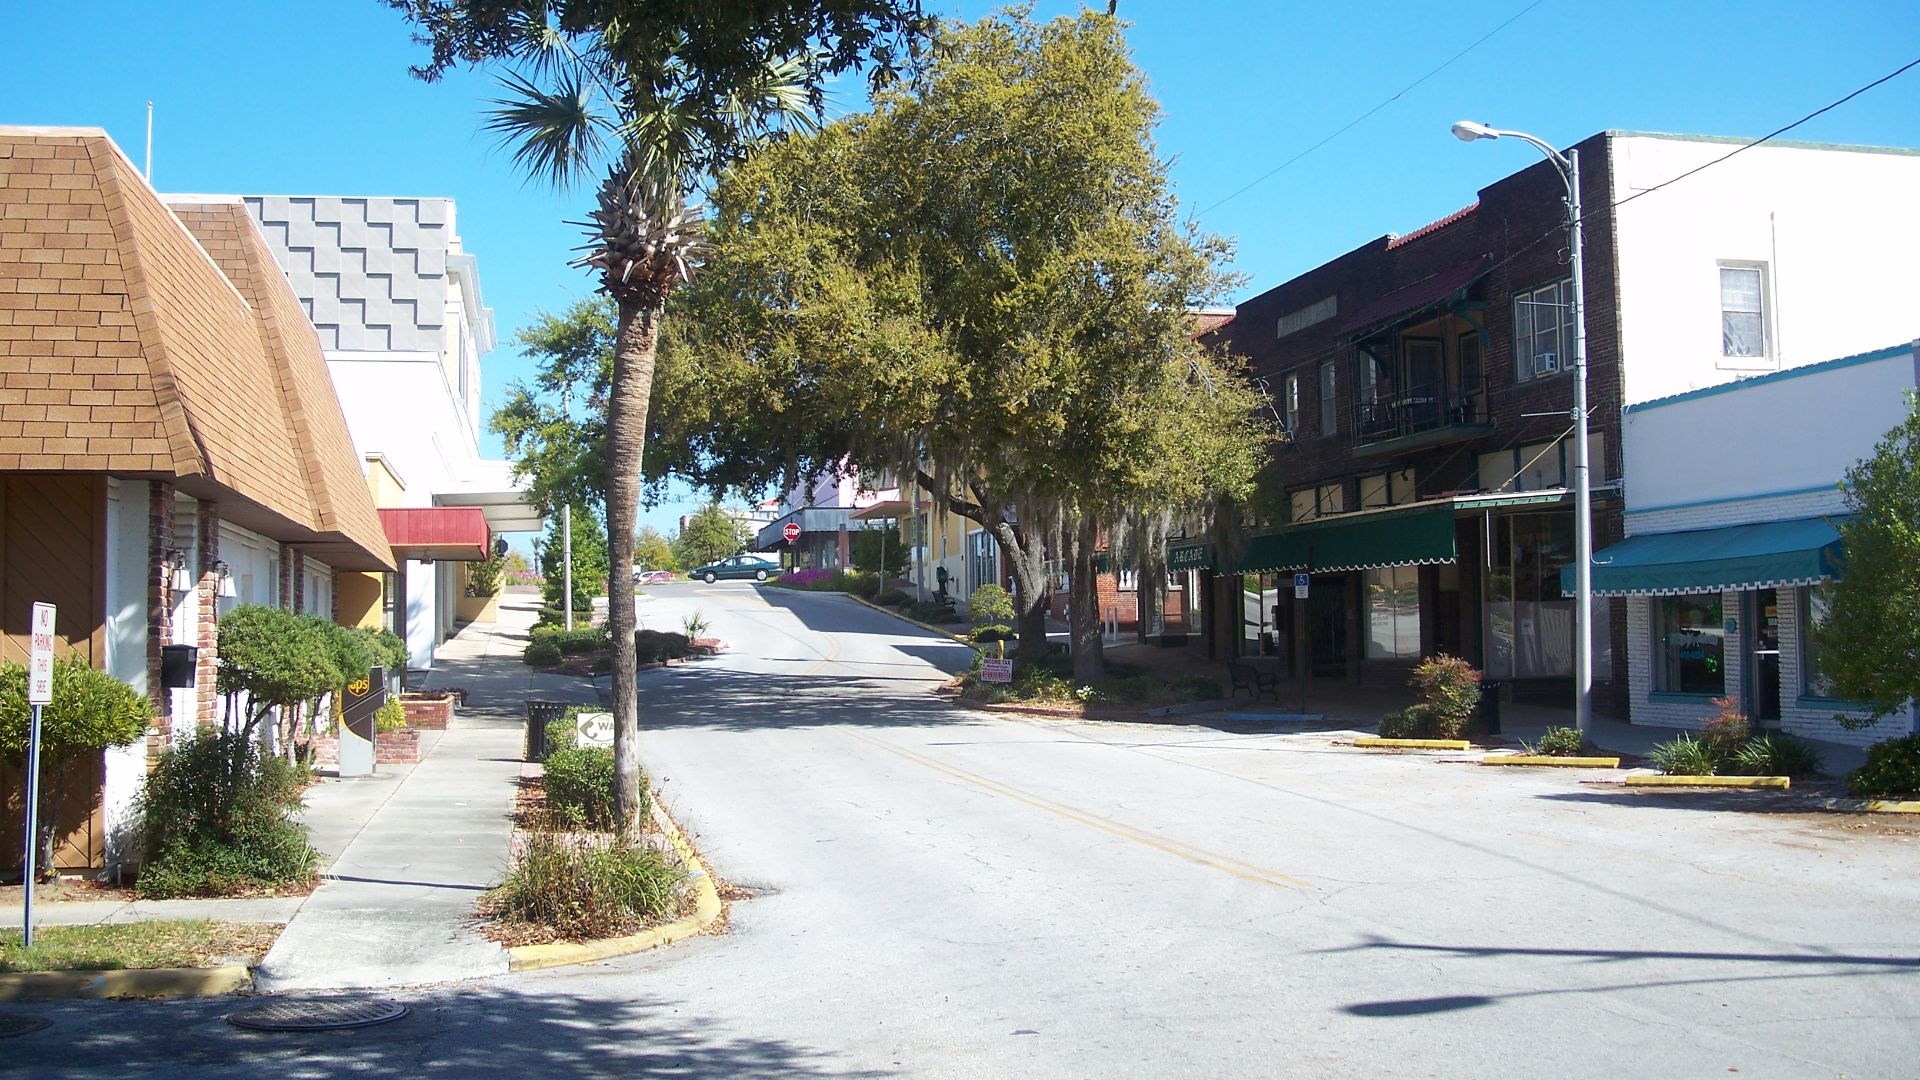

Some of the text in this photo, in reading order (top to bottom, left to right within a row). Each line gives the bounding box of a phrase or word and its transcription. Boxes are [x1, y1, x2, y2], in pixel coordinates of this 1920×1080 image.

[784, 528, 800, 536] STOP
[1173, 547, 1204, 563] ARCADE
[41, 608, 49, 628] NO
[34, 632, 52, 652] PARKING
[37, 658, 47, 673] THIS
[36, 679, 47, 693] SIDE
